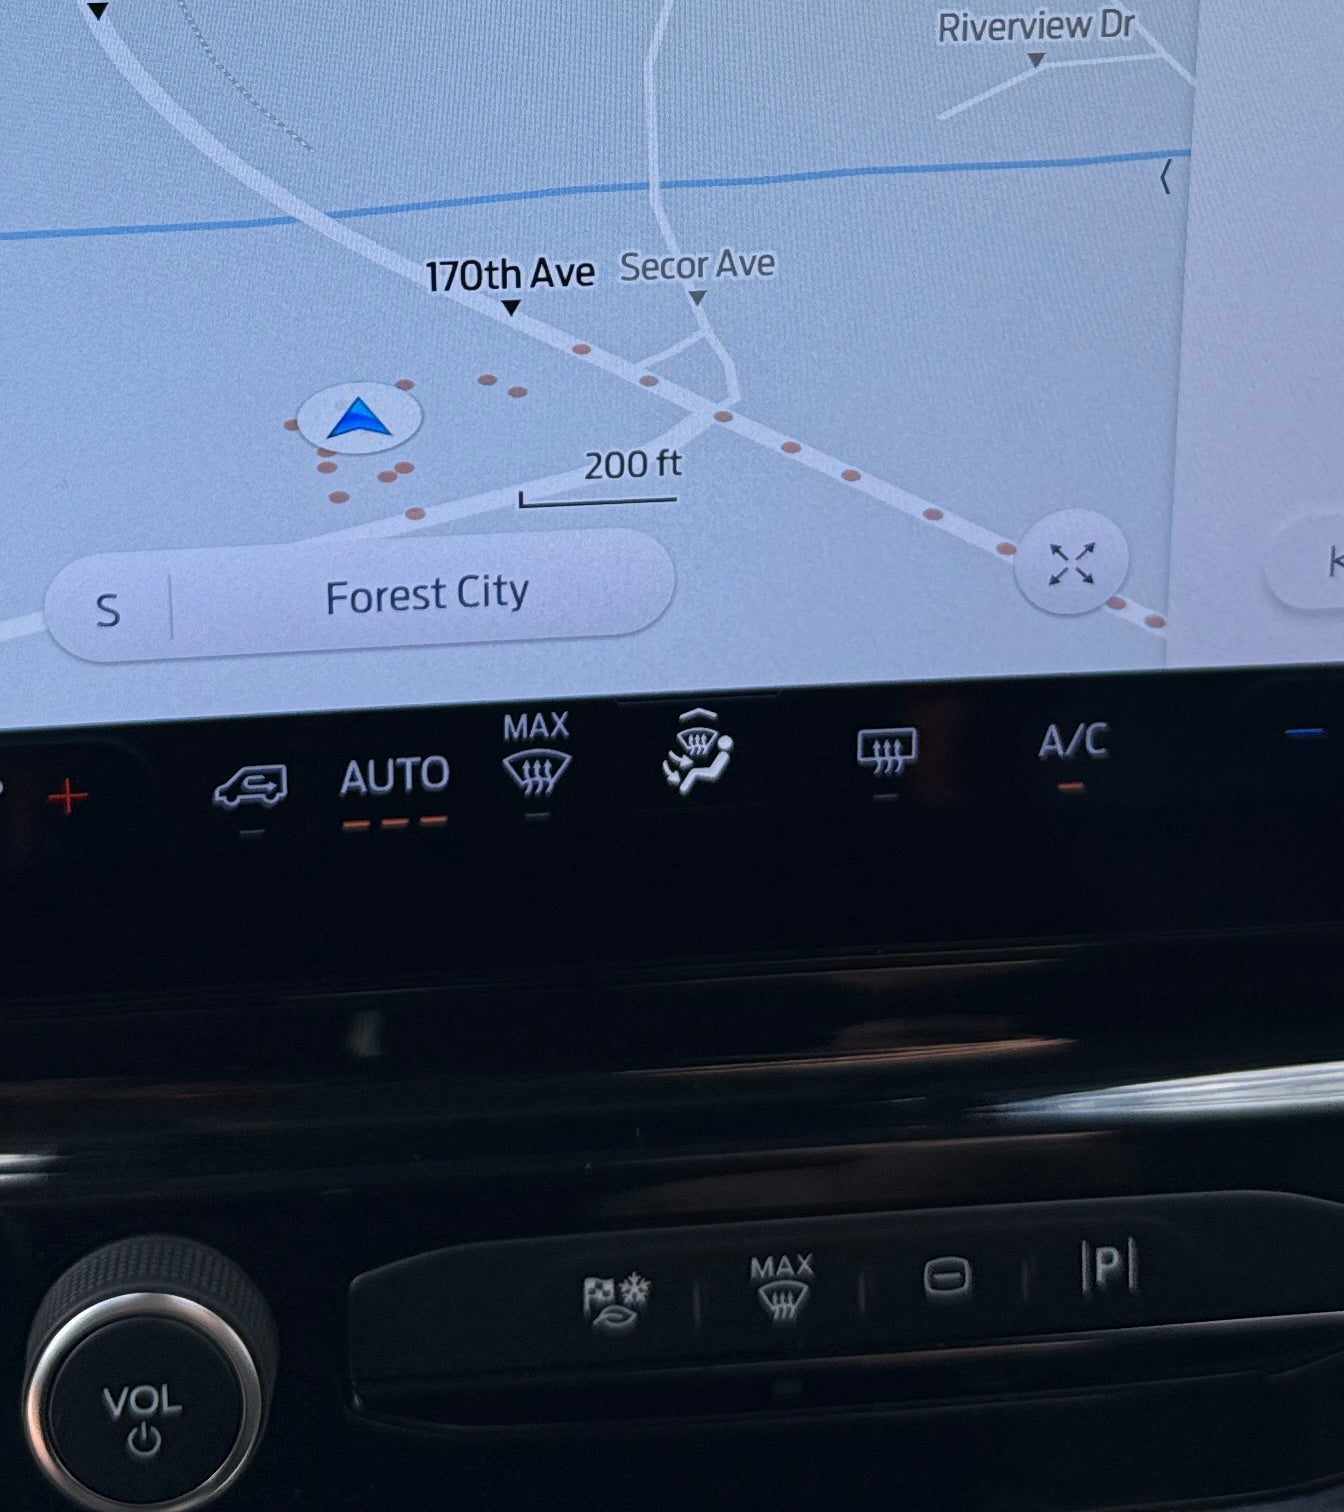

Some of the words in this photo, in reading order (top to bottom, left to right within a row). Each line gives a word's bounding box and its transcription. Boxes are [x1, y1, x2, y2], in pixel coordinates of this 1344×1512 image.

[938, 11, 1094, 42] Riverview
[1100, 7, 1136, 38] Dr
[425, 257, 522, 292] 170th
[529, 255, 596, 288] Ave
[620, 251, 710, 282] Secor
[715, 248, 776, 277] Ave
[584, 449, 648, 481] 200
[656, 448, 683, 477] ft
[96, 592, 121, 628] S
[326, 576, 447, 615] Forest
[457, 573, 530, 612] City
[503, 710, 570, 741] MAX
[1037, 721, 1111, 759] A/C
[339, 754, 450, 796] AUTO
[750, 1252, 814, 1282] MAX
[103, 1383, 183, 1418] VOL
